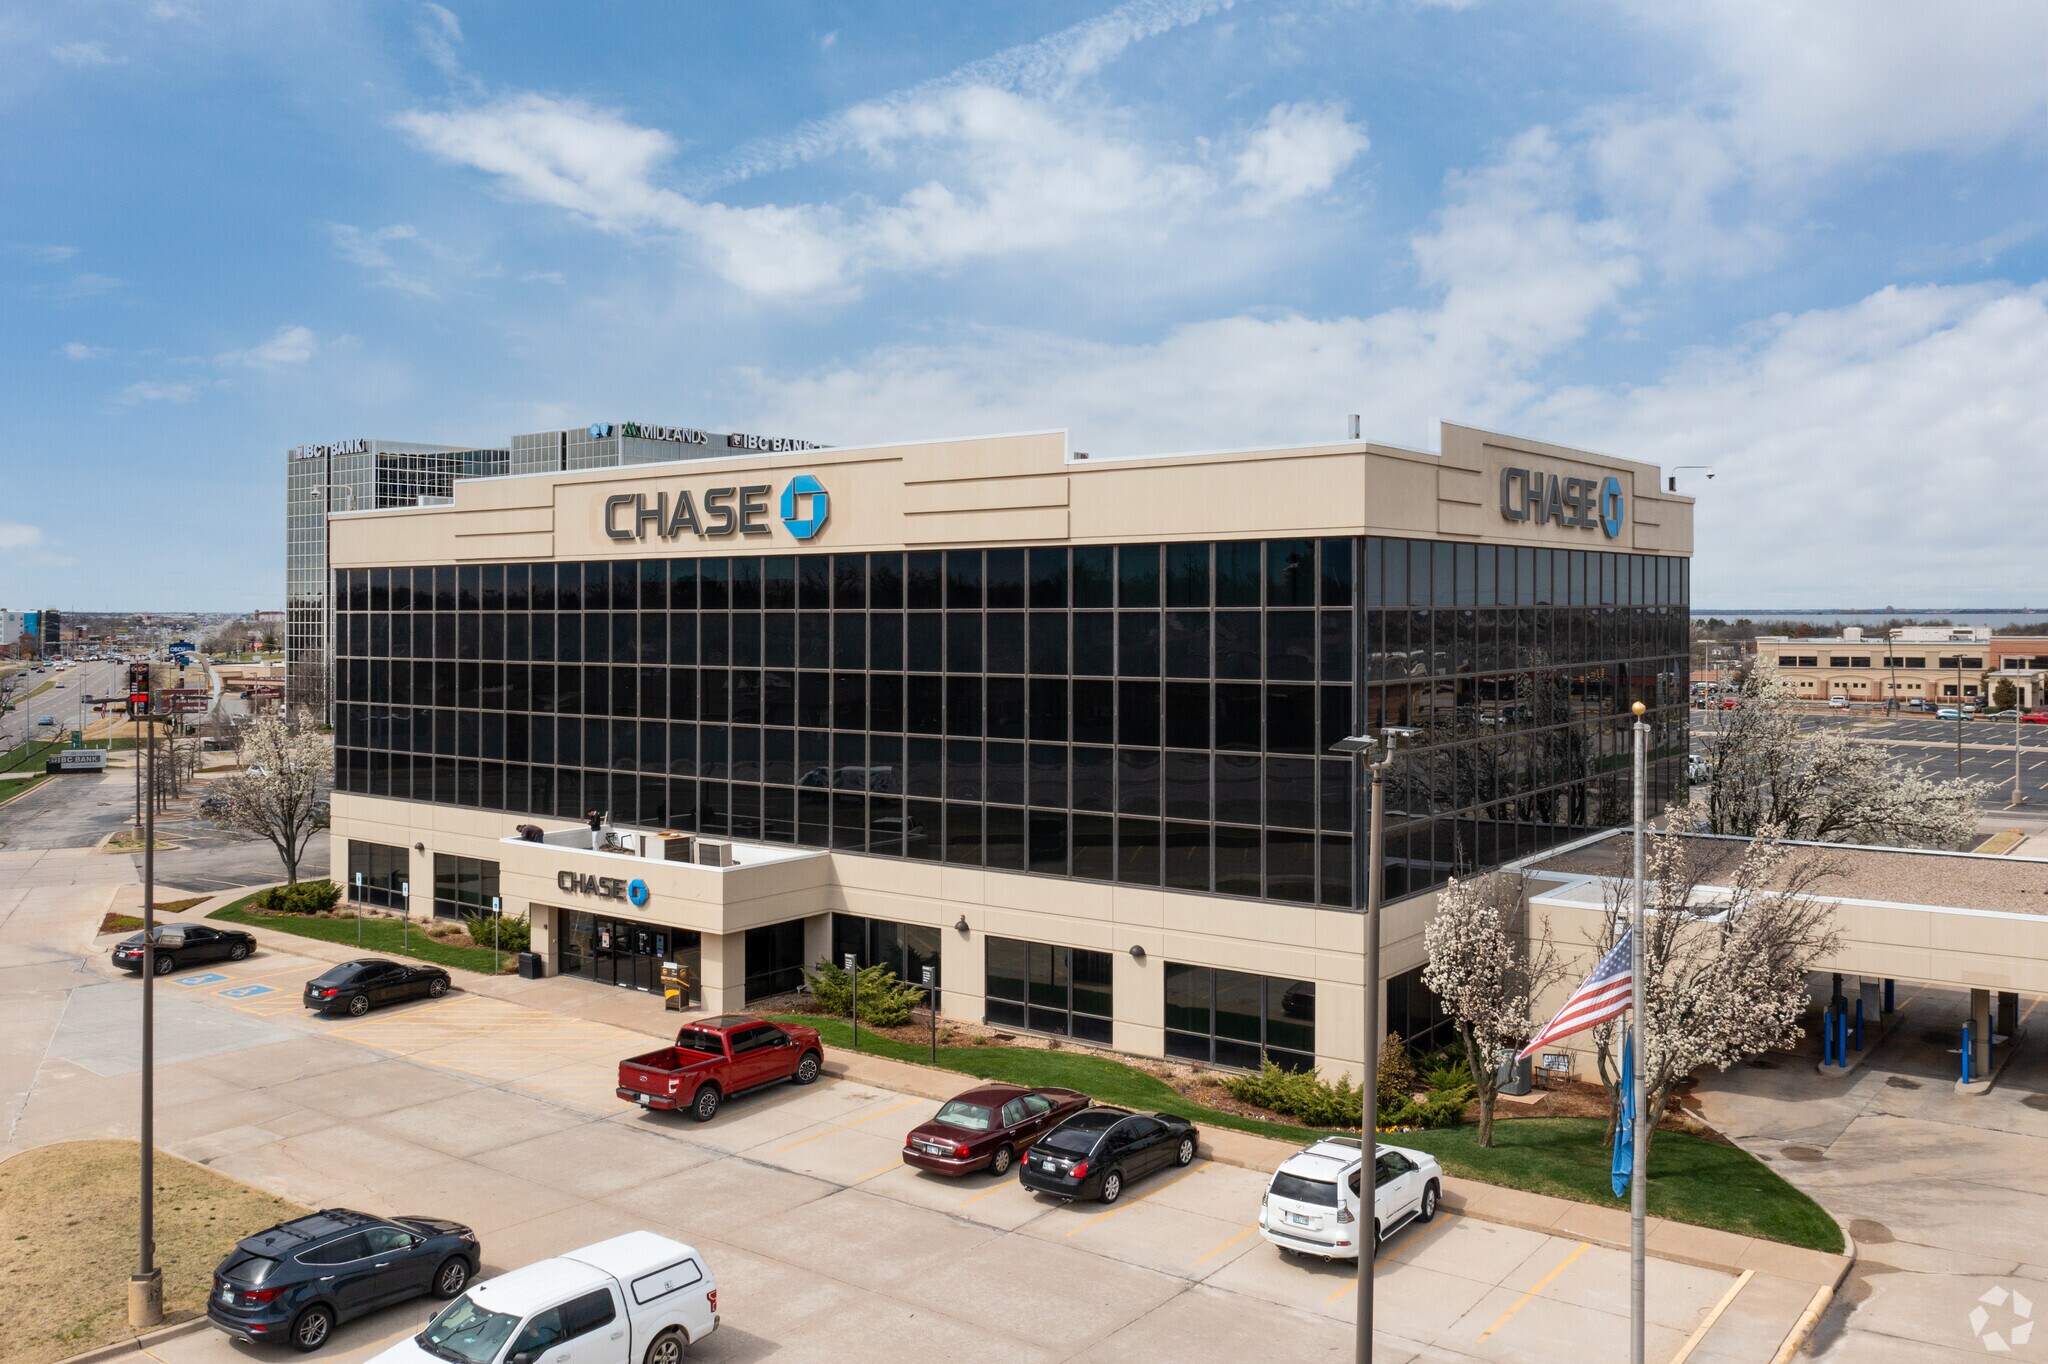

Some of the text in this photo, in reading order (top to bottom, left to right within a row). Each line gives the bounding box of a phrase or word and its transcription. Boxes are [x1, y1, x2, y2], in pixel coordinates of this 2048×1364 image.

[640, 423, 708, 445] MIDLANDS
[743, 433, 811, 452] IBC BANK
[303, 438, 365, 459] IBC BANK
[1499, 467, 1599, 529] CHASE
[605, 484, 772, 540] CHASE
[558, 870, 628, 900] CHASE
